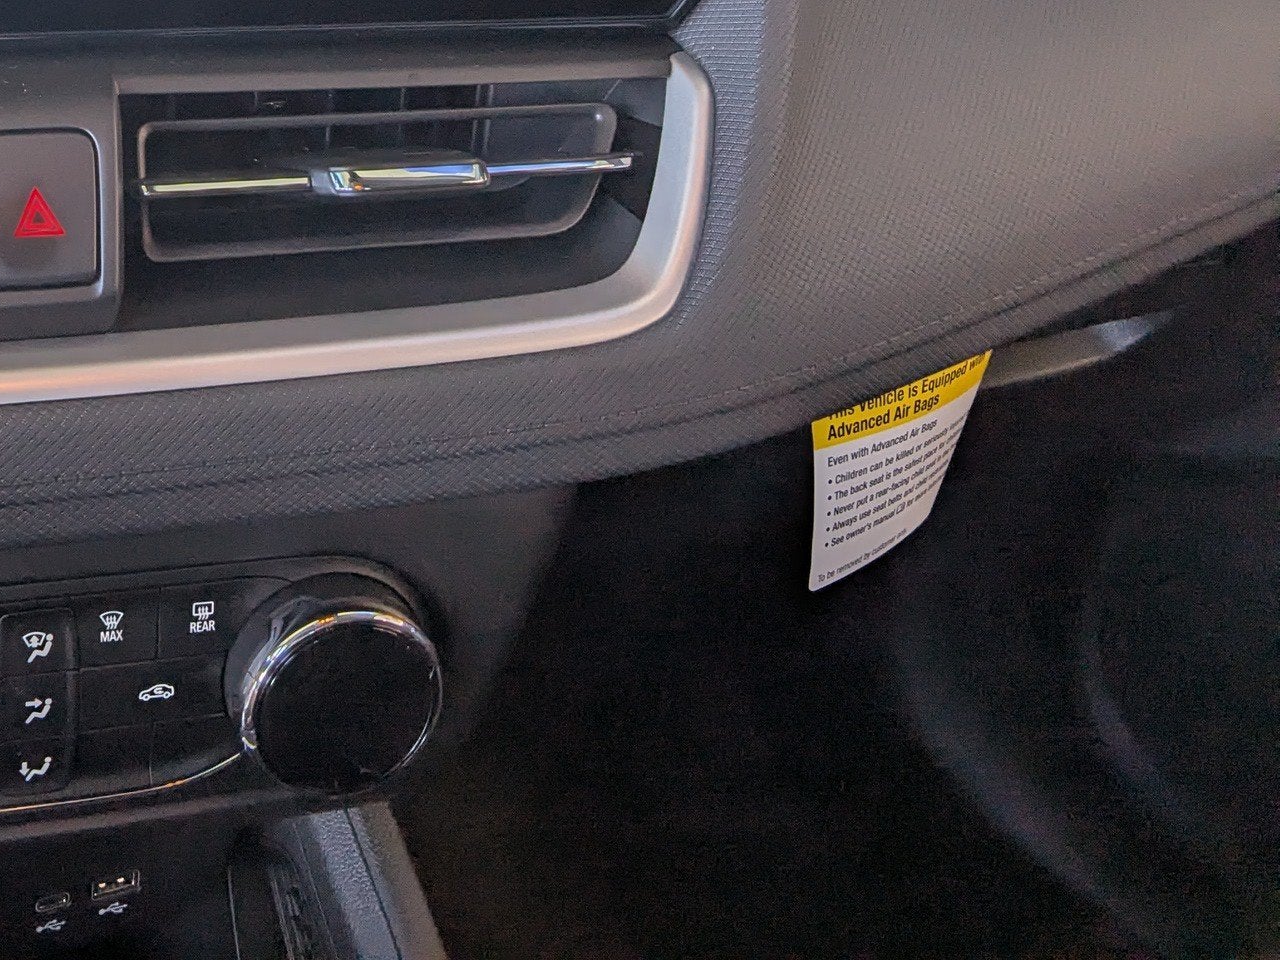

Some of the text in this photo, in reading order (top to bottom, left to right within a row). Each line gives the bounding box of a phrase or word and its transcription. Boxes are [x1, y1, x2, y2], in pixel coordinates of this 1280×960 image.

[907, 384, 918, 399] is
[921, 360, 968, 394] Equipped
[827, 393, 940, 441] Advanced Air Bags
[827, 418, 938, 468] Even with Advanced Air Bags
[834, 466, 868, 484] Children
[870, 461, 884, 472] can
[885, 456, 894, 467] be
[895, 445, 915, 462] killed
[915, 443, 923, 452] or
[833, 501, 856, 516] Never
[856, 495, 869, 509] put
[869, 494, 874, 502] a
[875, 476, 910, 499] rear-facing
[910, 466, 925, 481] child
[834, 489, 849, 501] The
[850, 480, 868, 495] back
[869, 473, 884, 487] seat
[885, 471, 892, 480] is
[893, 466, 904, 477] the
[904, 455, 923, 472] safest
[922, 446, 938, 462] place
[830, 536, 844, 547] See
[845, 522, 872, 540] owner's
[872, 508, 895, 528] manual
[831, 515, 858, 532] Always
[858, 509, 871, 521] use
[872, 499, 888, 515] seat
[887, 493, 903, 507] belts
[903, 483, 915, 498] and
[818, 573, 826, 583] To
[826, 570, 835, 579] be
[836, 555, 863, 574] removed
[99, 629, 124, 643] MAX
[189, 619, 216, 633] REAR
